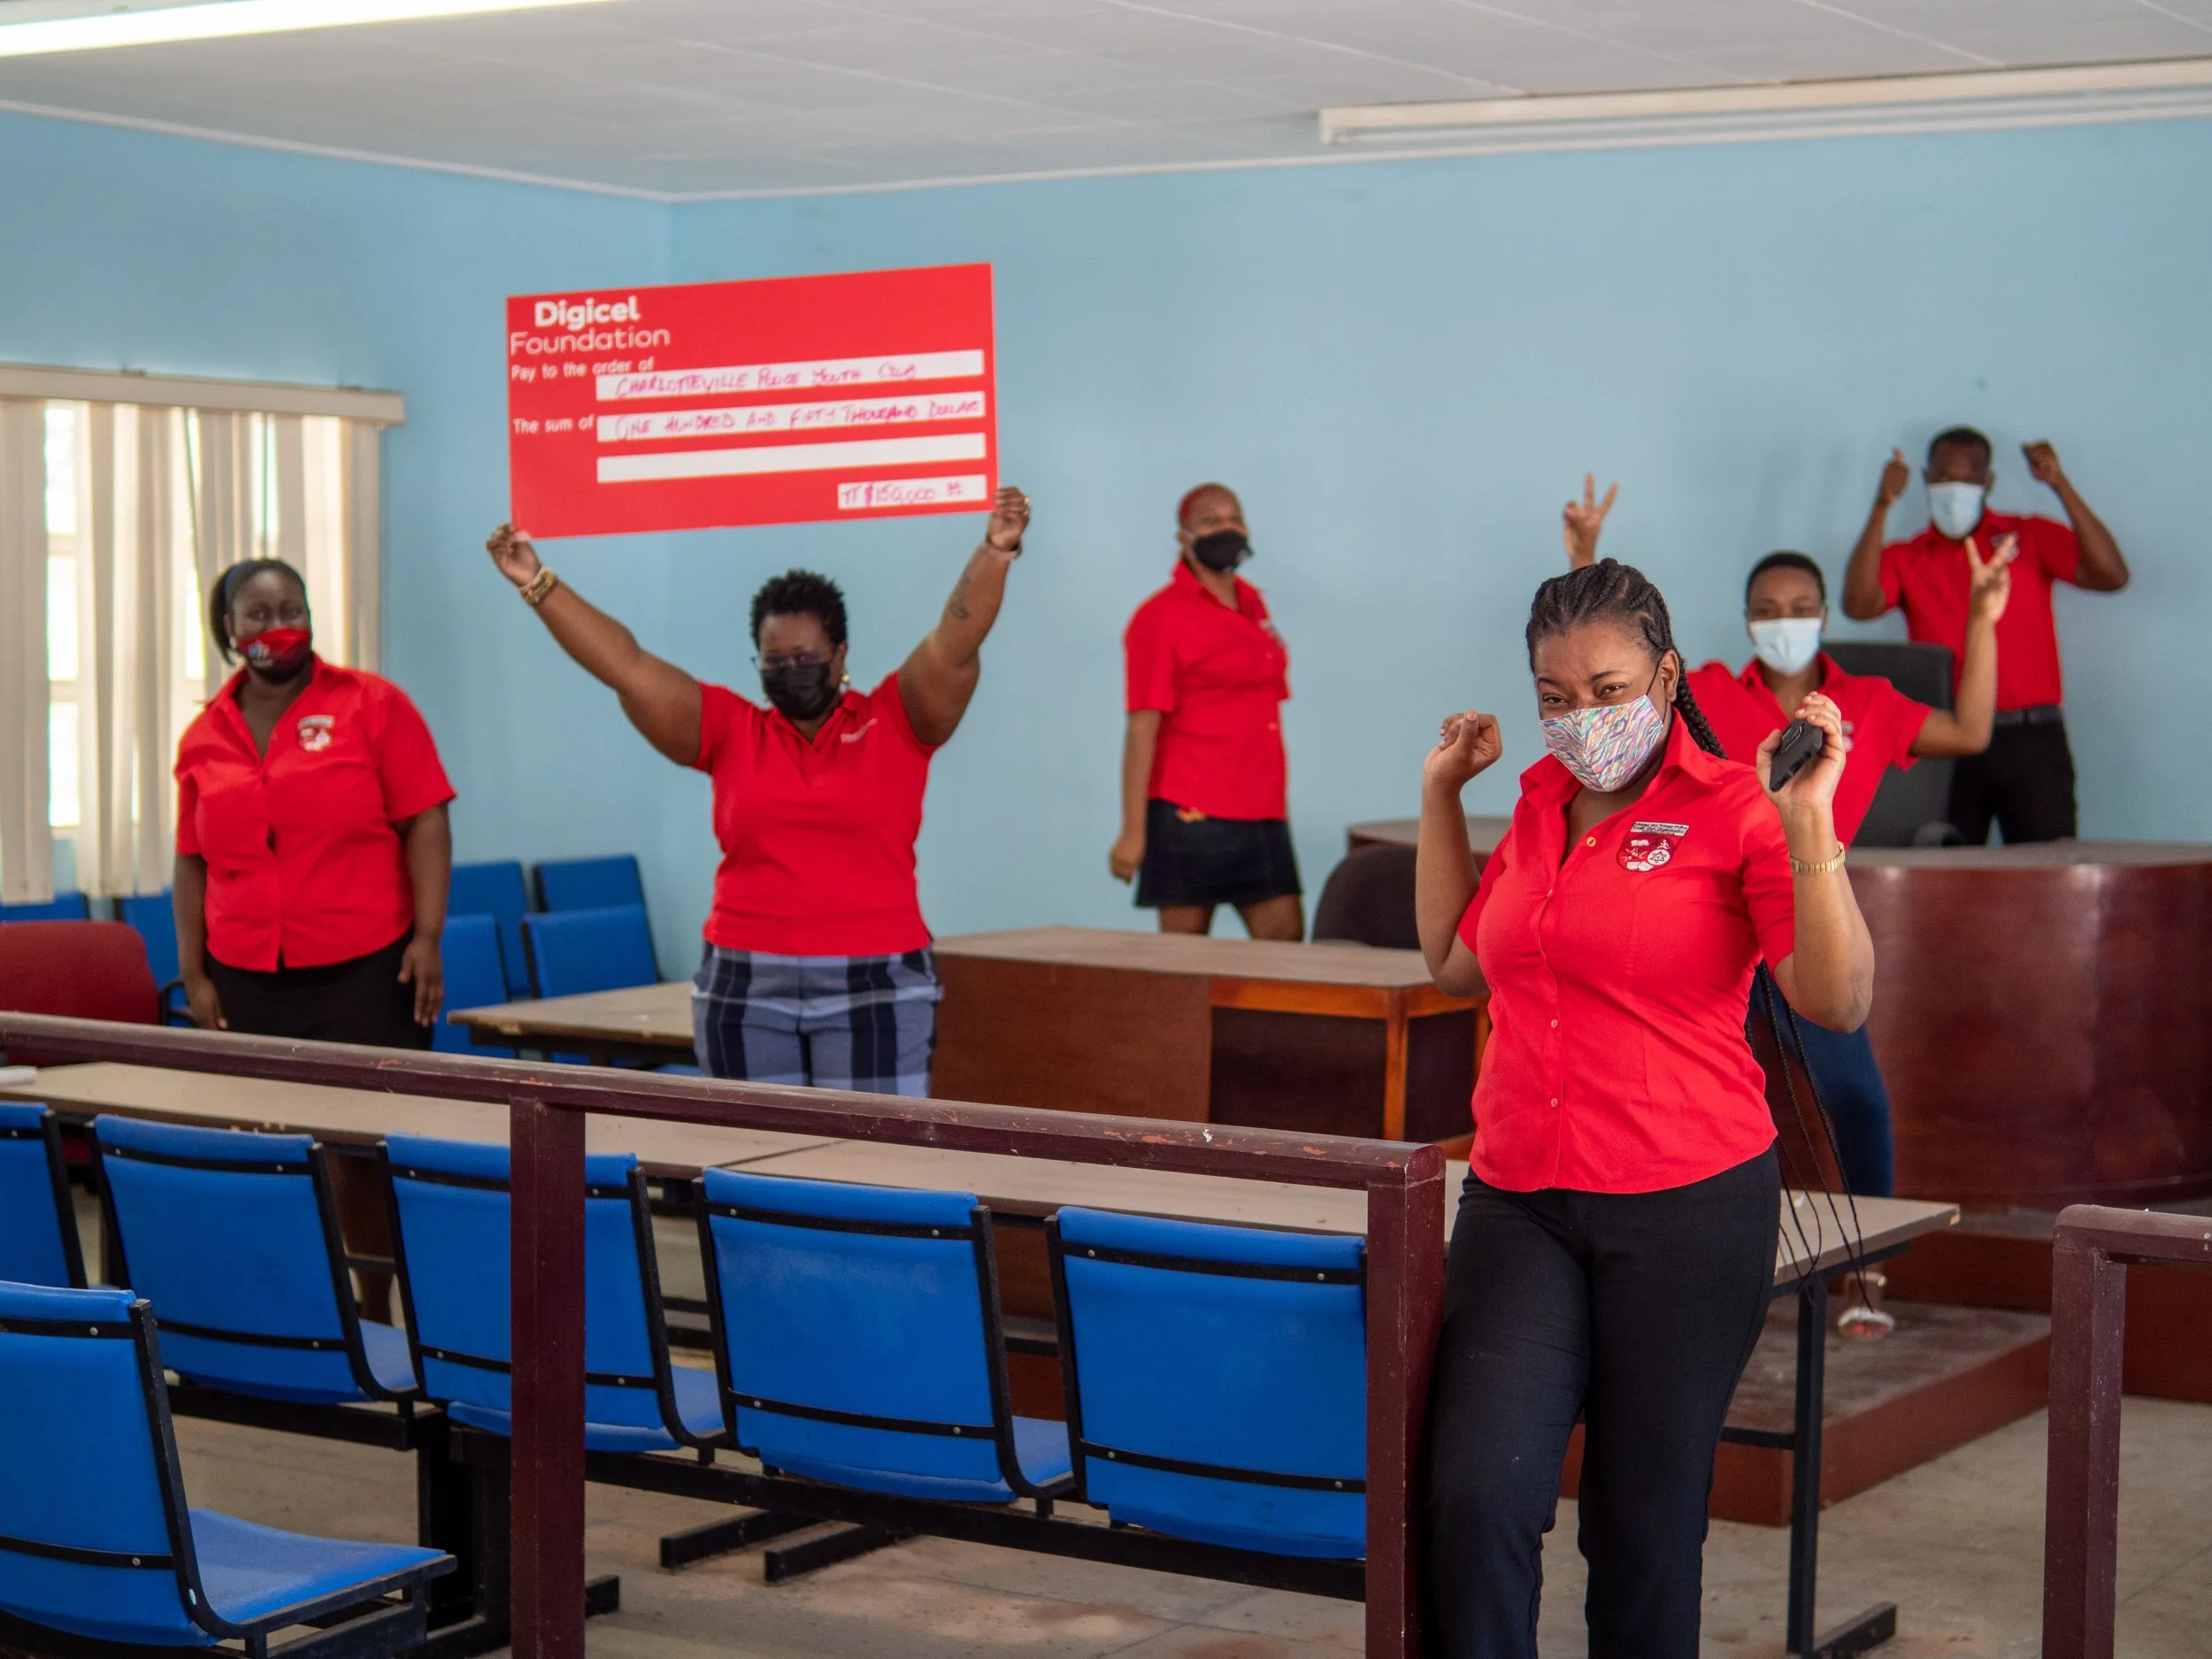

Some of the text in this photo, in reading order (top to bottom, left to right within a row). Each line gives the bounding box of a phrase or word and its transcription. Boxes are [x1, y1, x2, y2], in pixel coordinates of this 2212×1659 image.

[534, 296, 641, 331] Digicel
[510, 326, 671, 356] Foundation
[511, 356, 655, 382] Pay to the order of
[615, 373, 750, 399] CHARLOTTEVILLE
[512, 413, 594, 434] The sum of
[615, 415, 653, 441] ONE
[745, 410, 777, 429] AND
